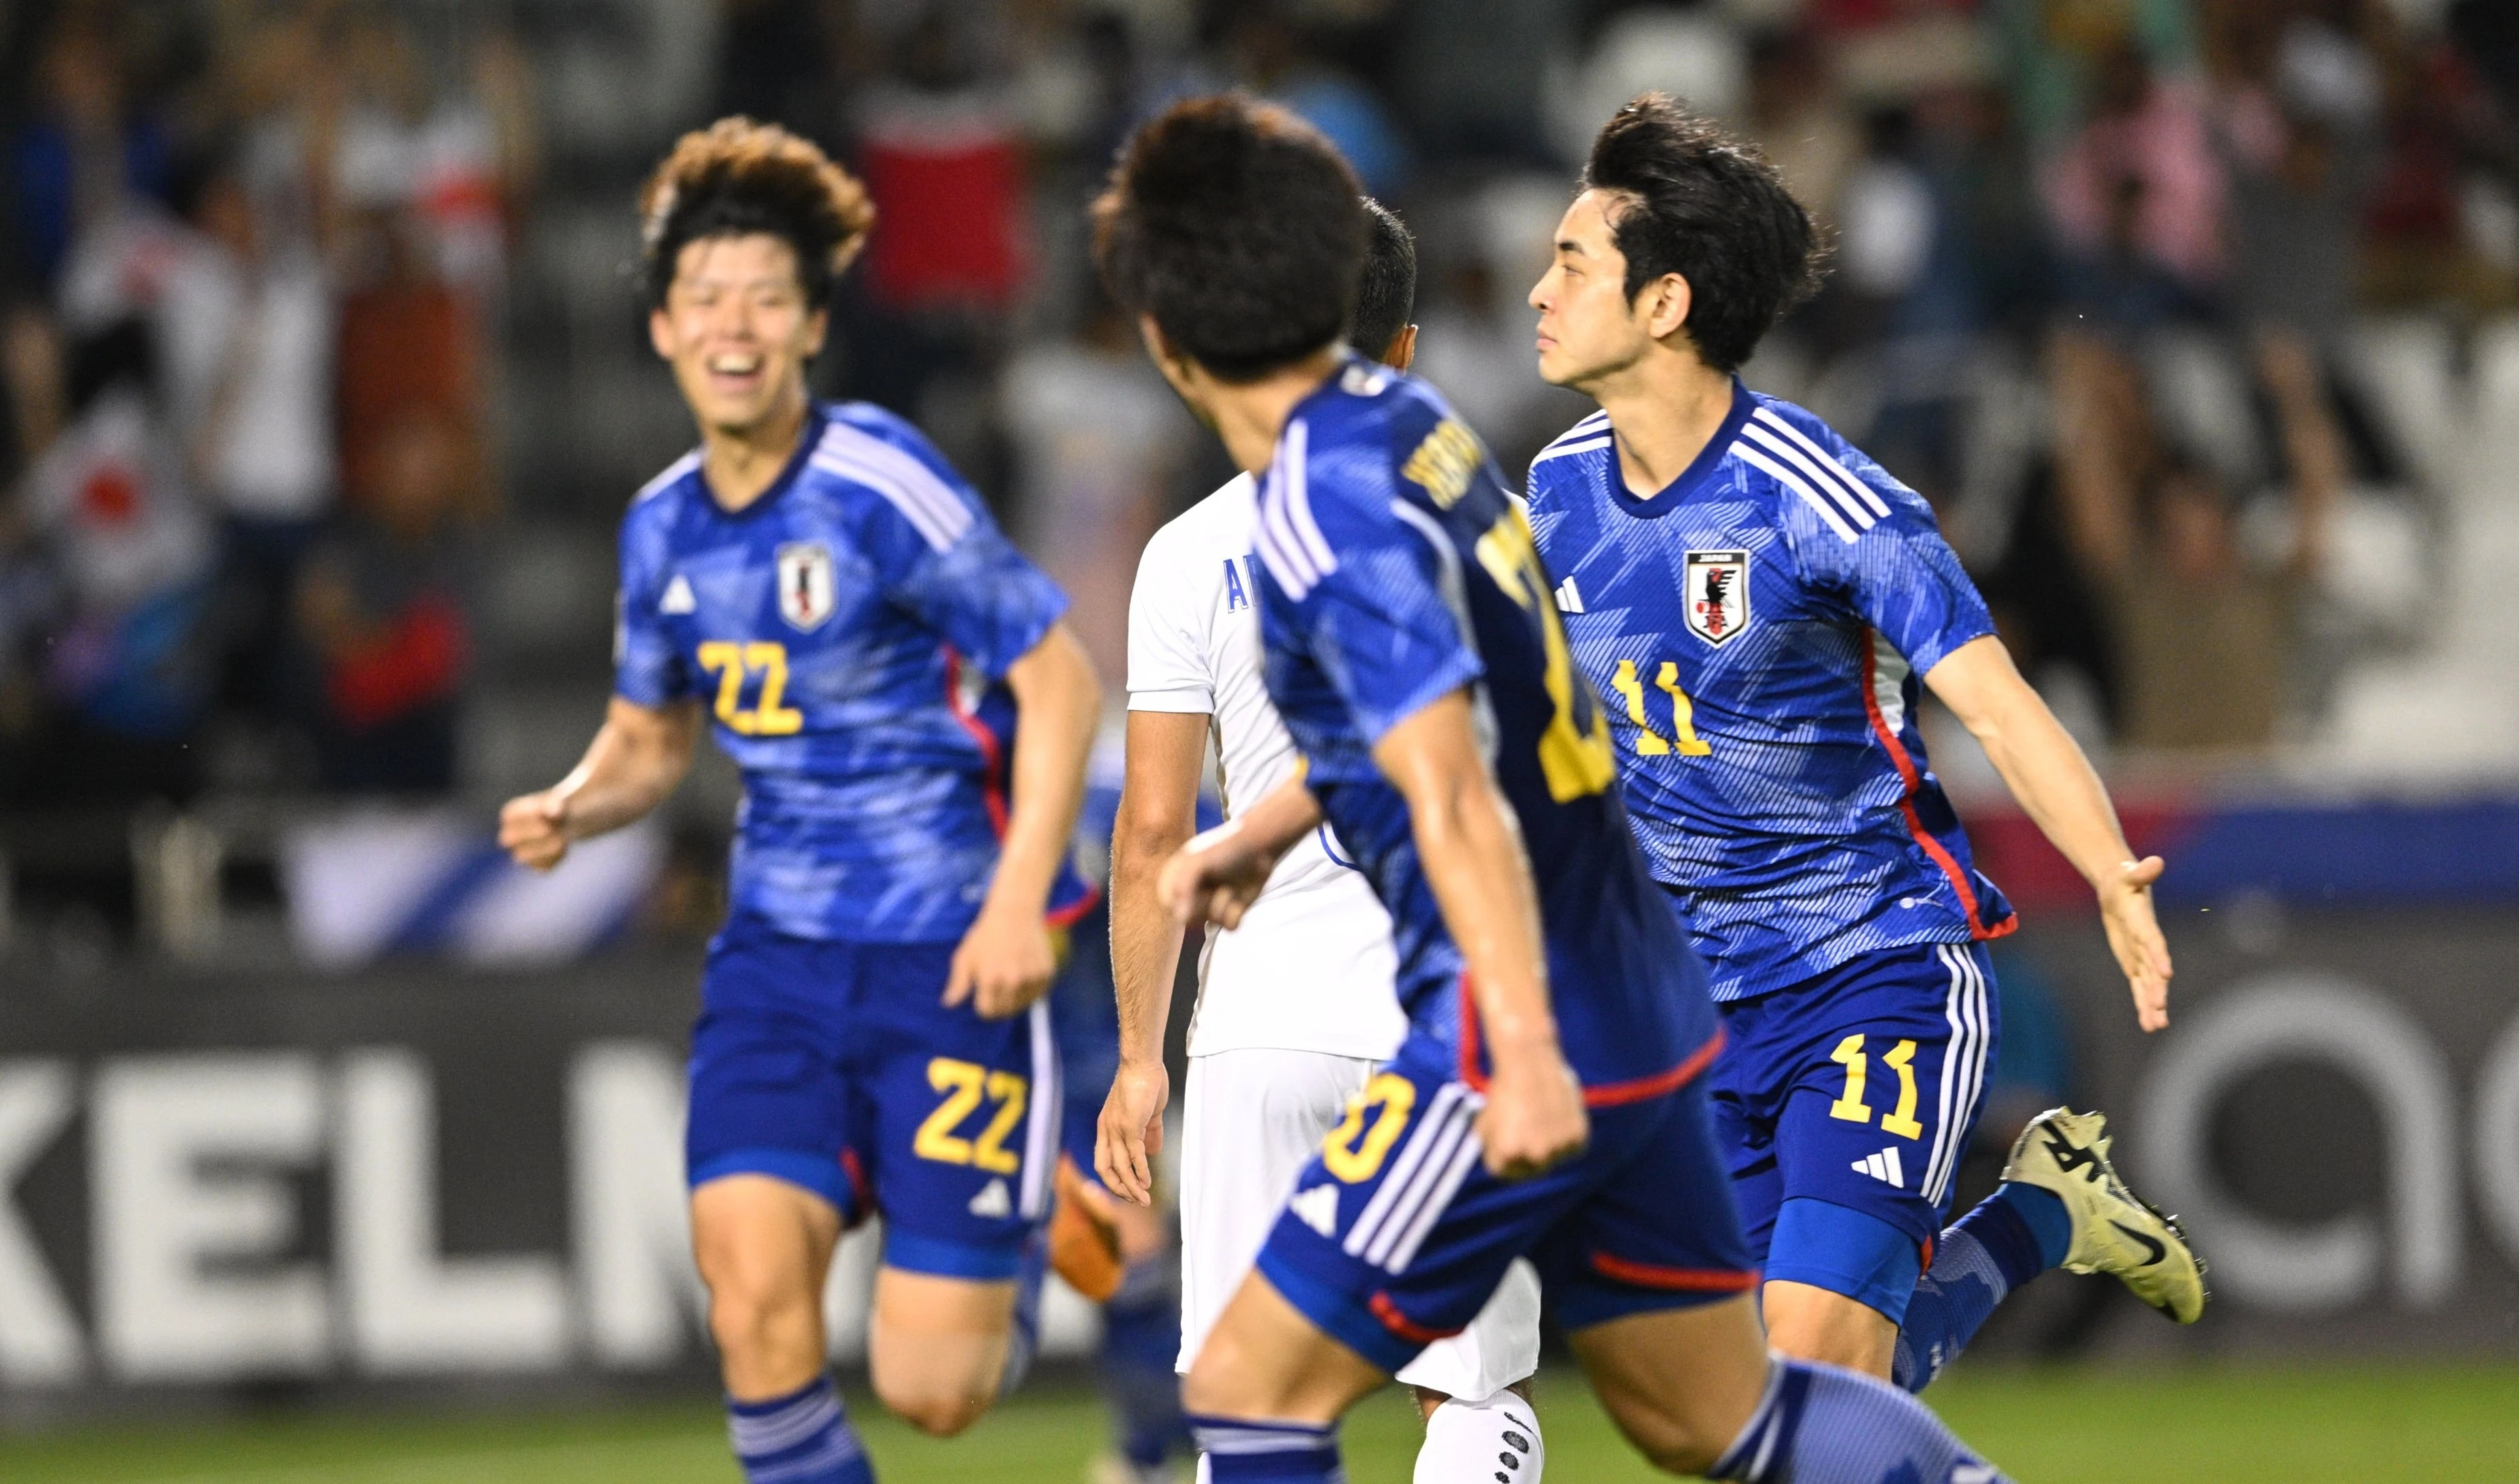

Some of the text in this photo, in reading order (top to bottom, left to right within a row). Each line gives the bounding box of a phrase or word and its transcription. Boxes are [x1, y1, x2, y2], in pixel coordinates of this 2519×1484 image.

[698, 642, 803, 735] 22
[1611, 660, 1712, 756] 11
[914, 1056, 1027, 1176] 22
[1829, 1033, 1923, 1141] 11
